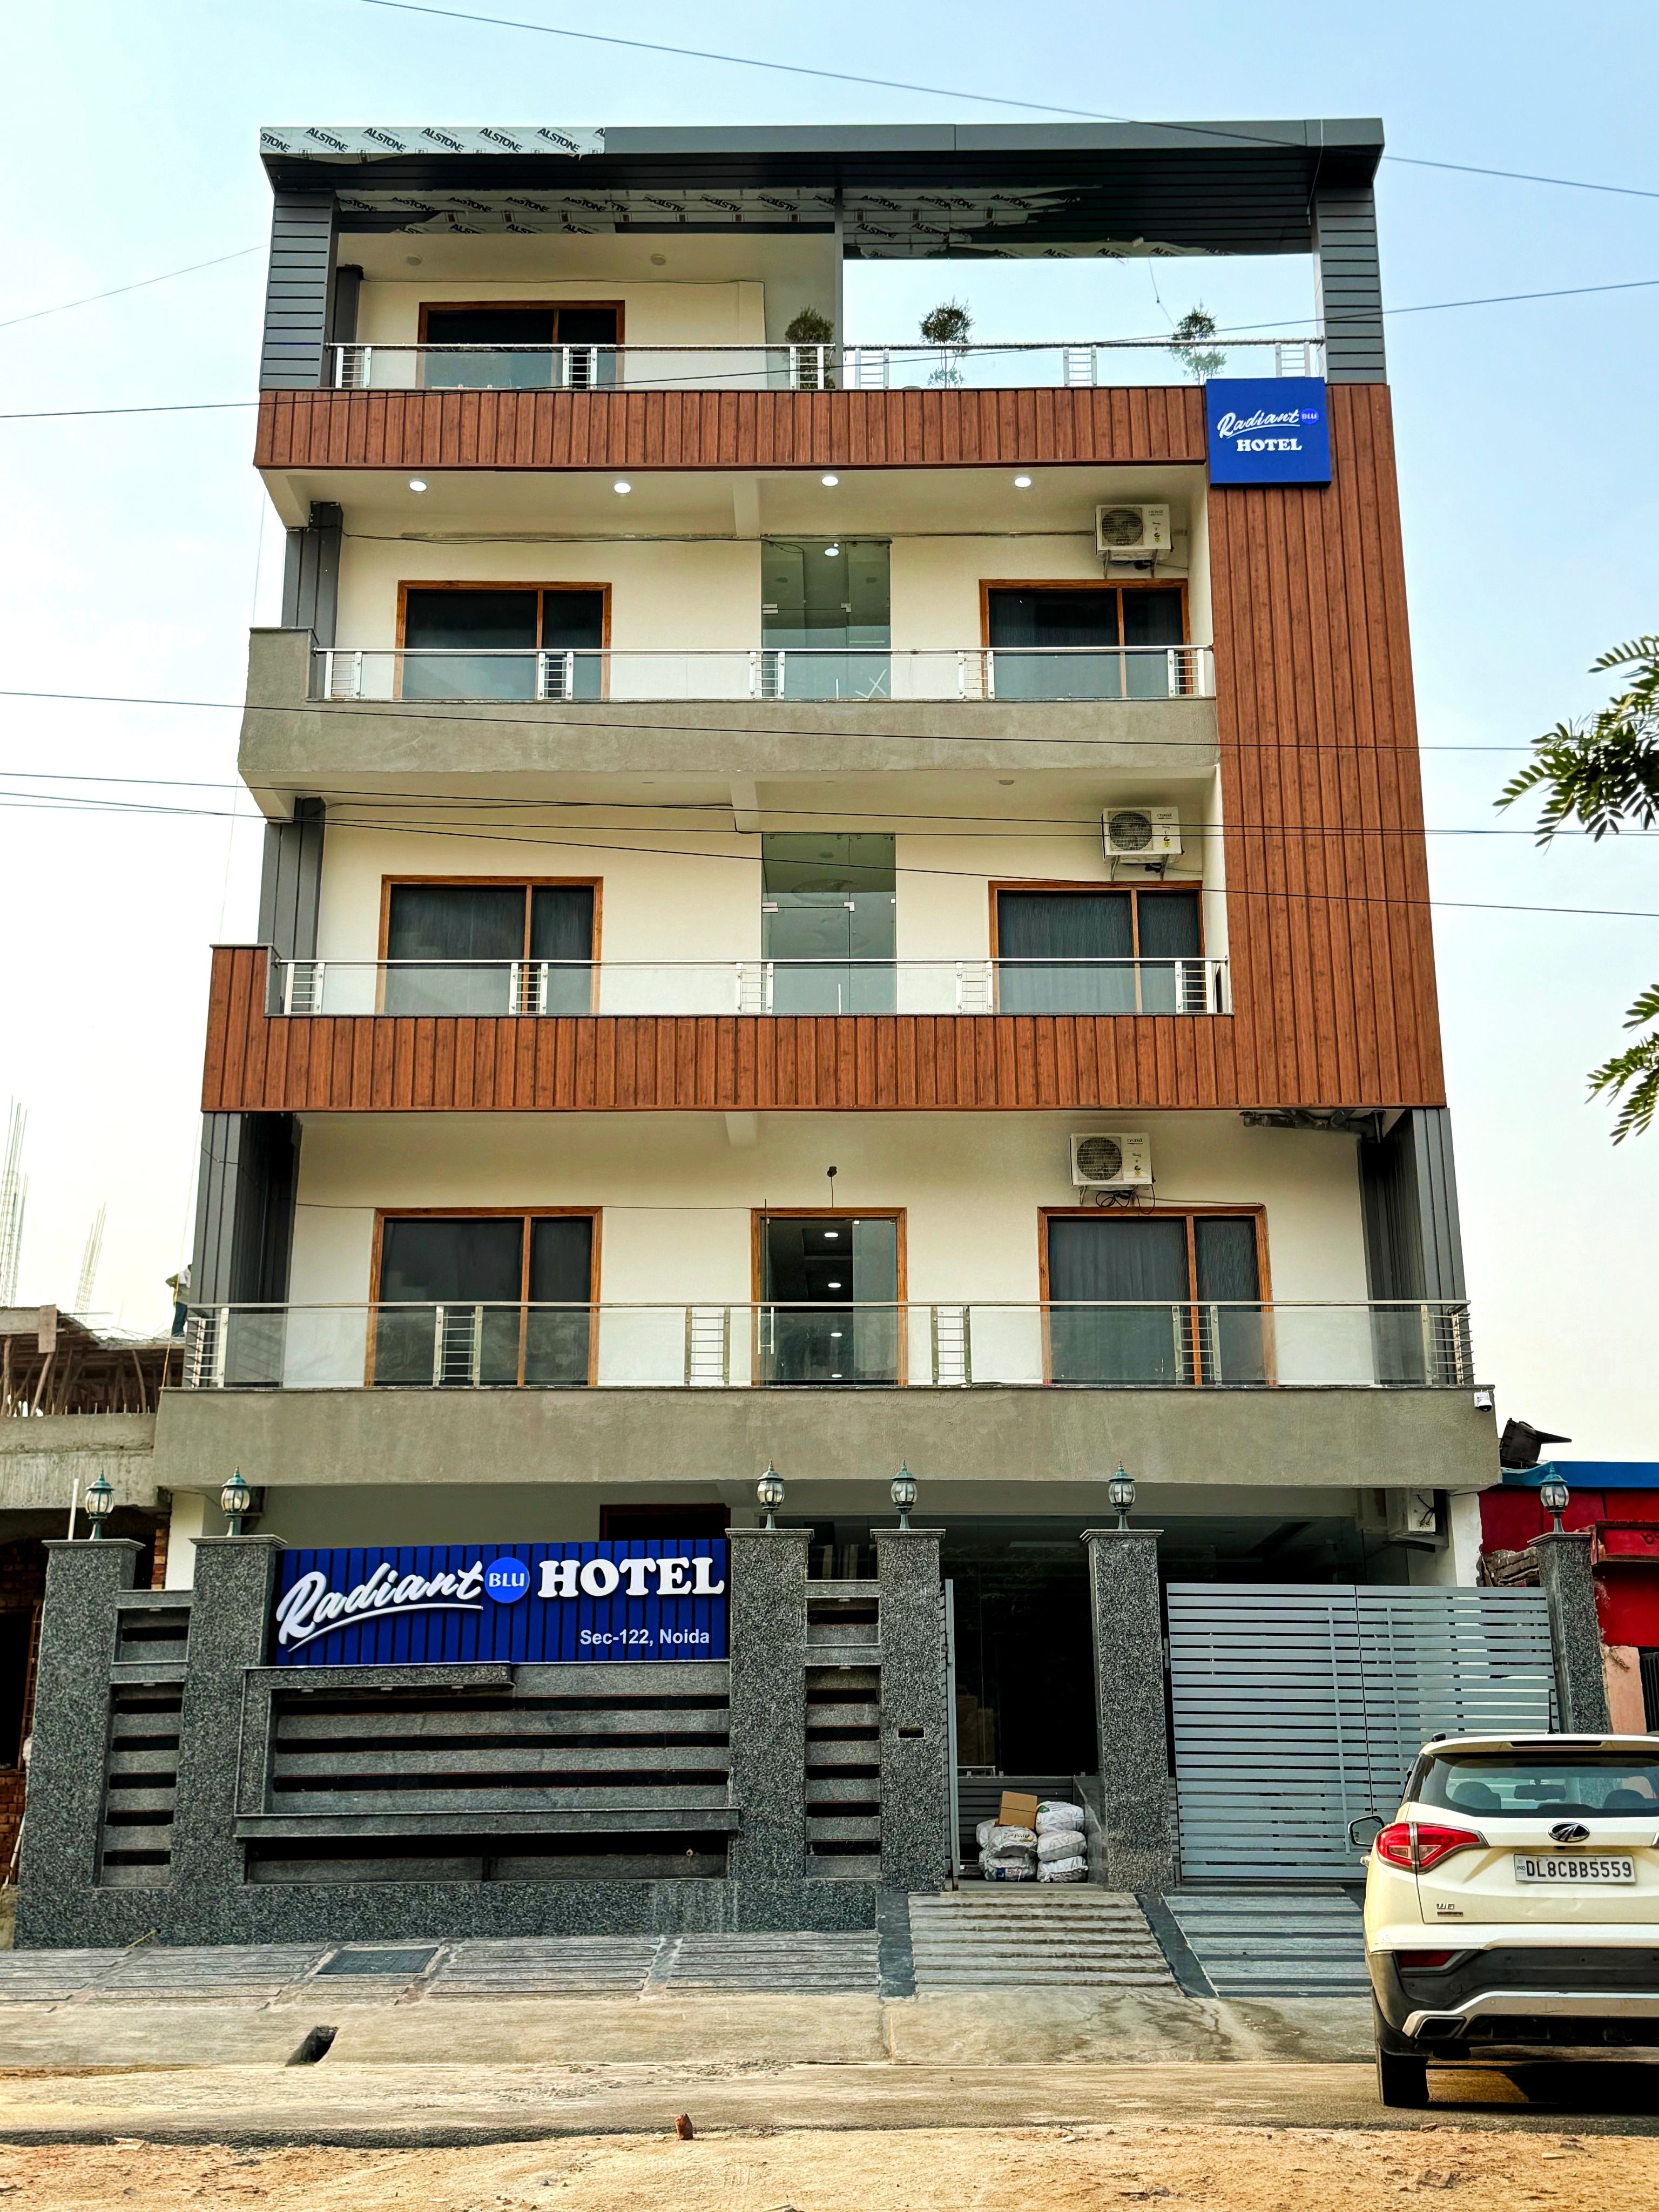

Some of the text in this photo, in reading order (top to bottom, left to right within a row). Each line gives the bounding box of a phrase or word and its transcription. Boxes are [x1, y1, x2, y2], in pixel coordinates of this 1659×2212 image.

[306, 127, 349, 153] ALSTONE
[363, 127, 407, 153] ALSTONE
[421, 127, 466, 153] ALSTONE
[479, 127, 523, 153] ALSTONE
[537, 127, 582, 153] ALSTONE
[1217, 409, 1300, 439] Radiant
[1236, 438, 1302, 451] HOTEL
[275, 1557, 725, 1645] Radiant BLU HOTEL
[579, 1629, 710, 1647] Sec-122, Noida
[1526, 1859, 1632, 1878] DL8CBB5559
